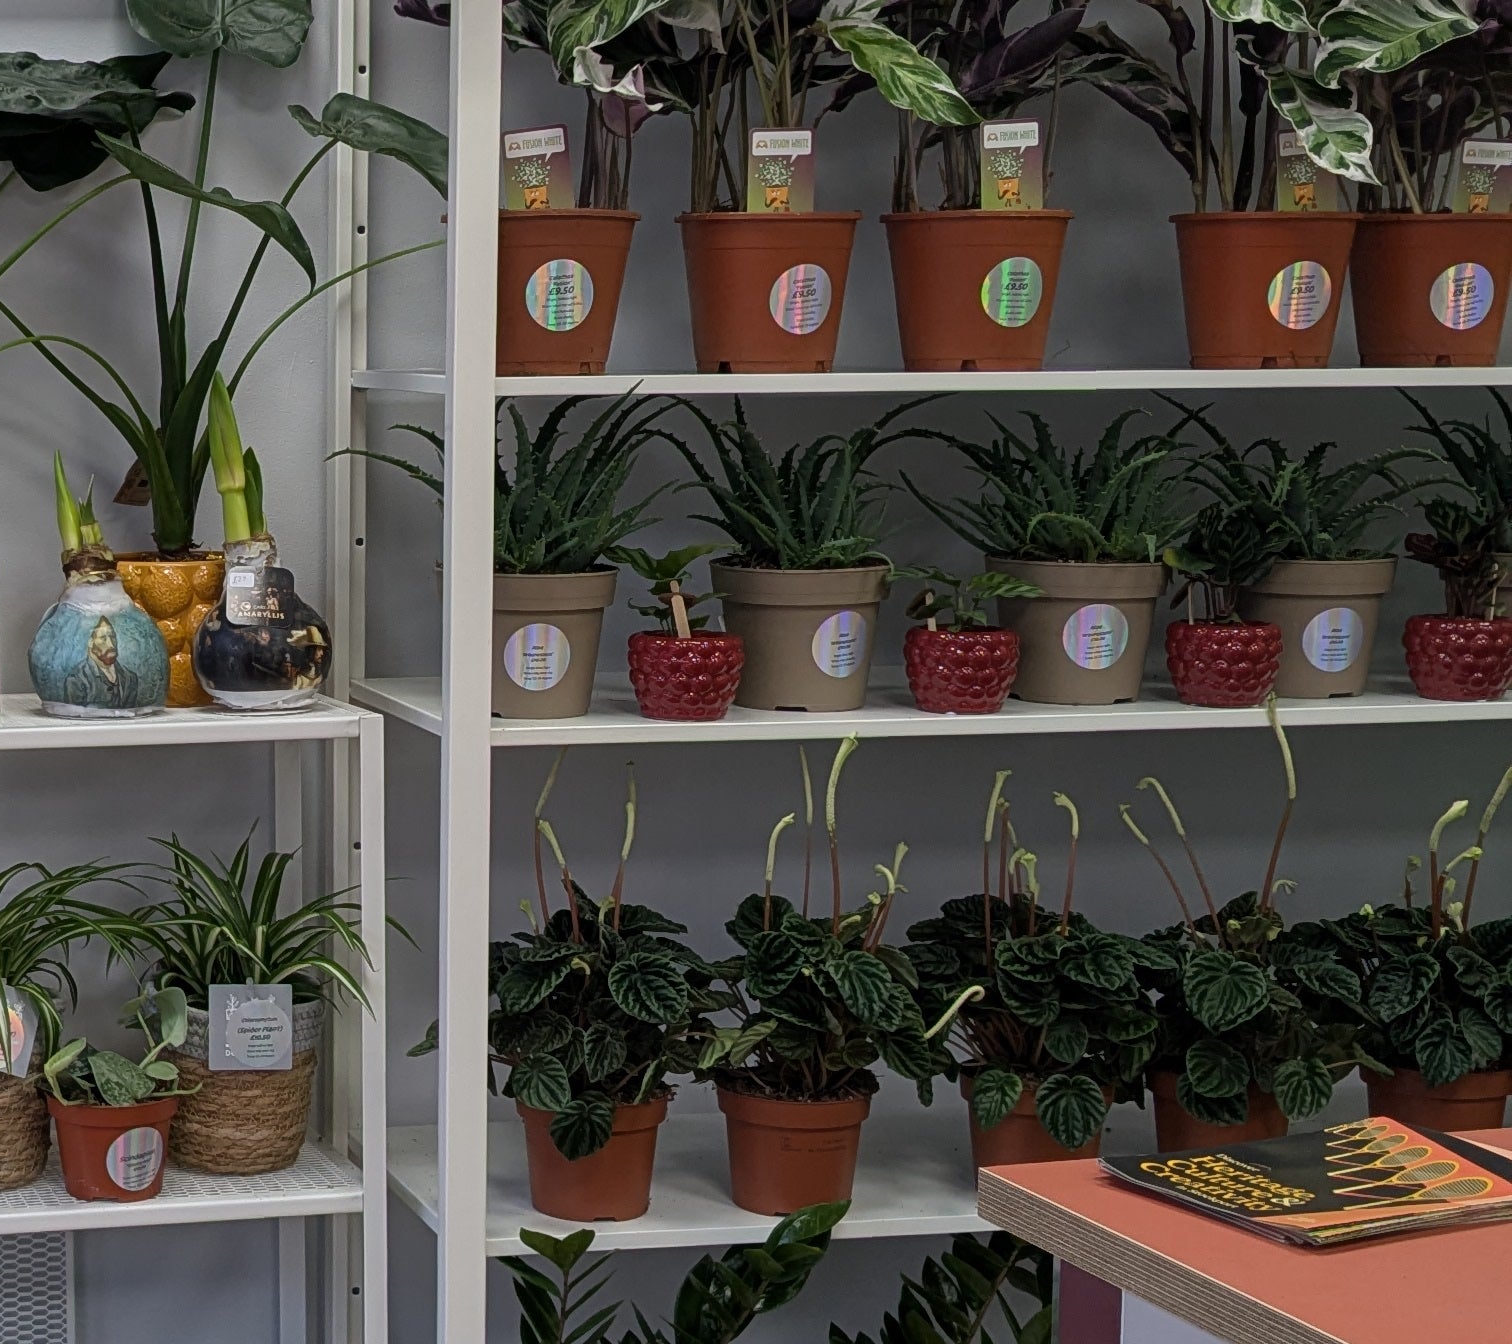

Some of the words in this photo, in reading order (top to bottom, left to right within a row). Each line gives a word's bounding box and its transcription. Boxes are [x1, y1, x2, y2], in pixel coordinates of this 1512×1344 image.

[548, 286, 575, 296] £9.50
[1004, 282, 1029, 291] £9.50
[1290, 285, 1315, 295] £9.50
[792, 289, 816, 299] £9.50
[237, 611, 285, 619] AMARYLLIS
[1166, 1159, 1273, 1199] Culture
[1189, 1155, 1316, 1200] Heritage
[1140, 1162, 1283, 1211] Creativity
